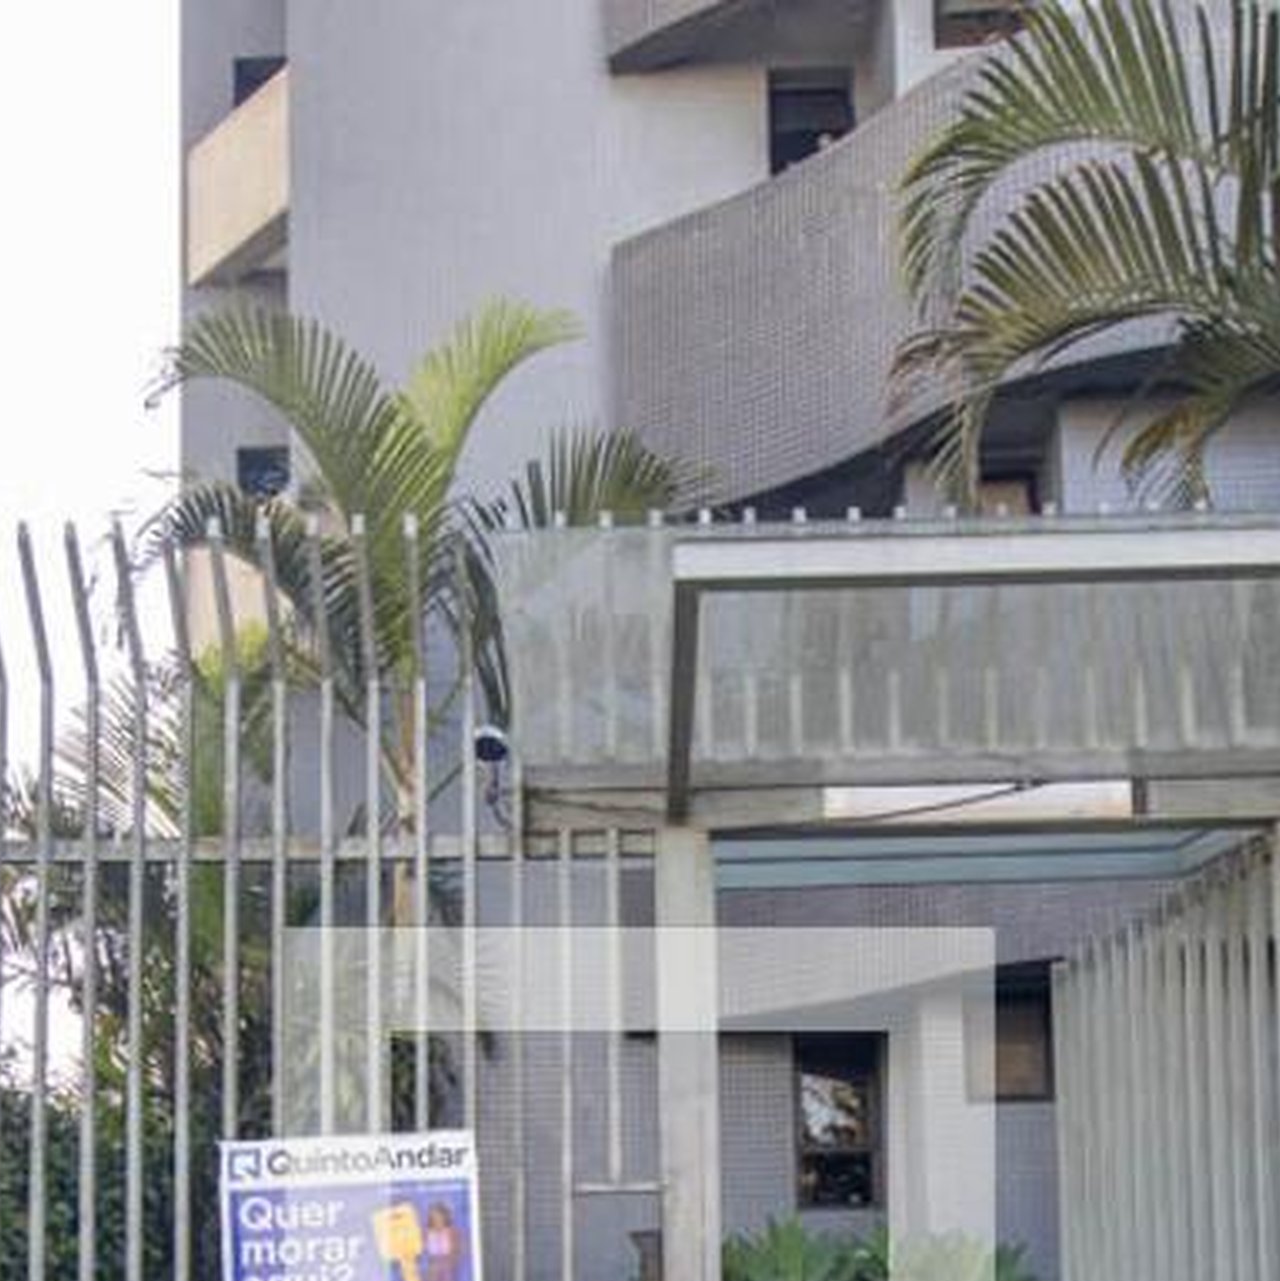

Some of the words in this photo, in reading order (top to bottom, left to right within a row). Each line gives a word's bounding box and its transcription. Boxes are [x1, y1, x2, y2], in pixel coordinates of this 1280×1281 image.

[267, 1143, 467, 1177] QuintoAndar
[239, 1197, 344, 1231] Quer
[241, 1236, 361, 1267] morar
